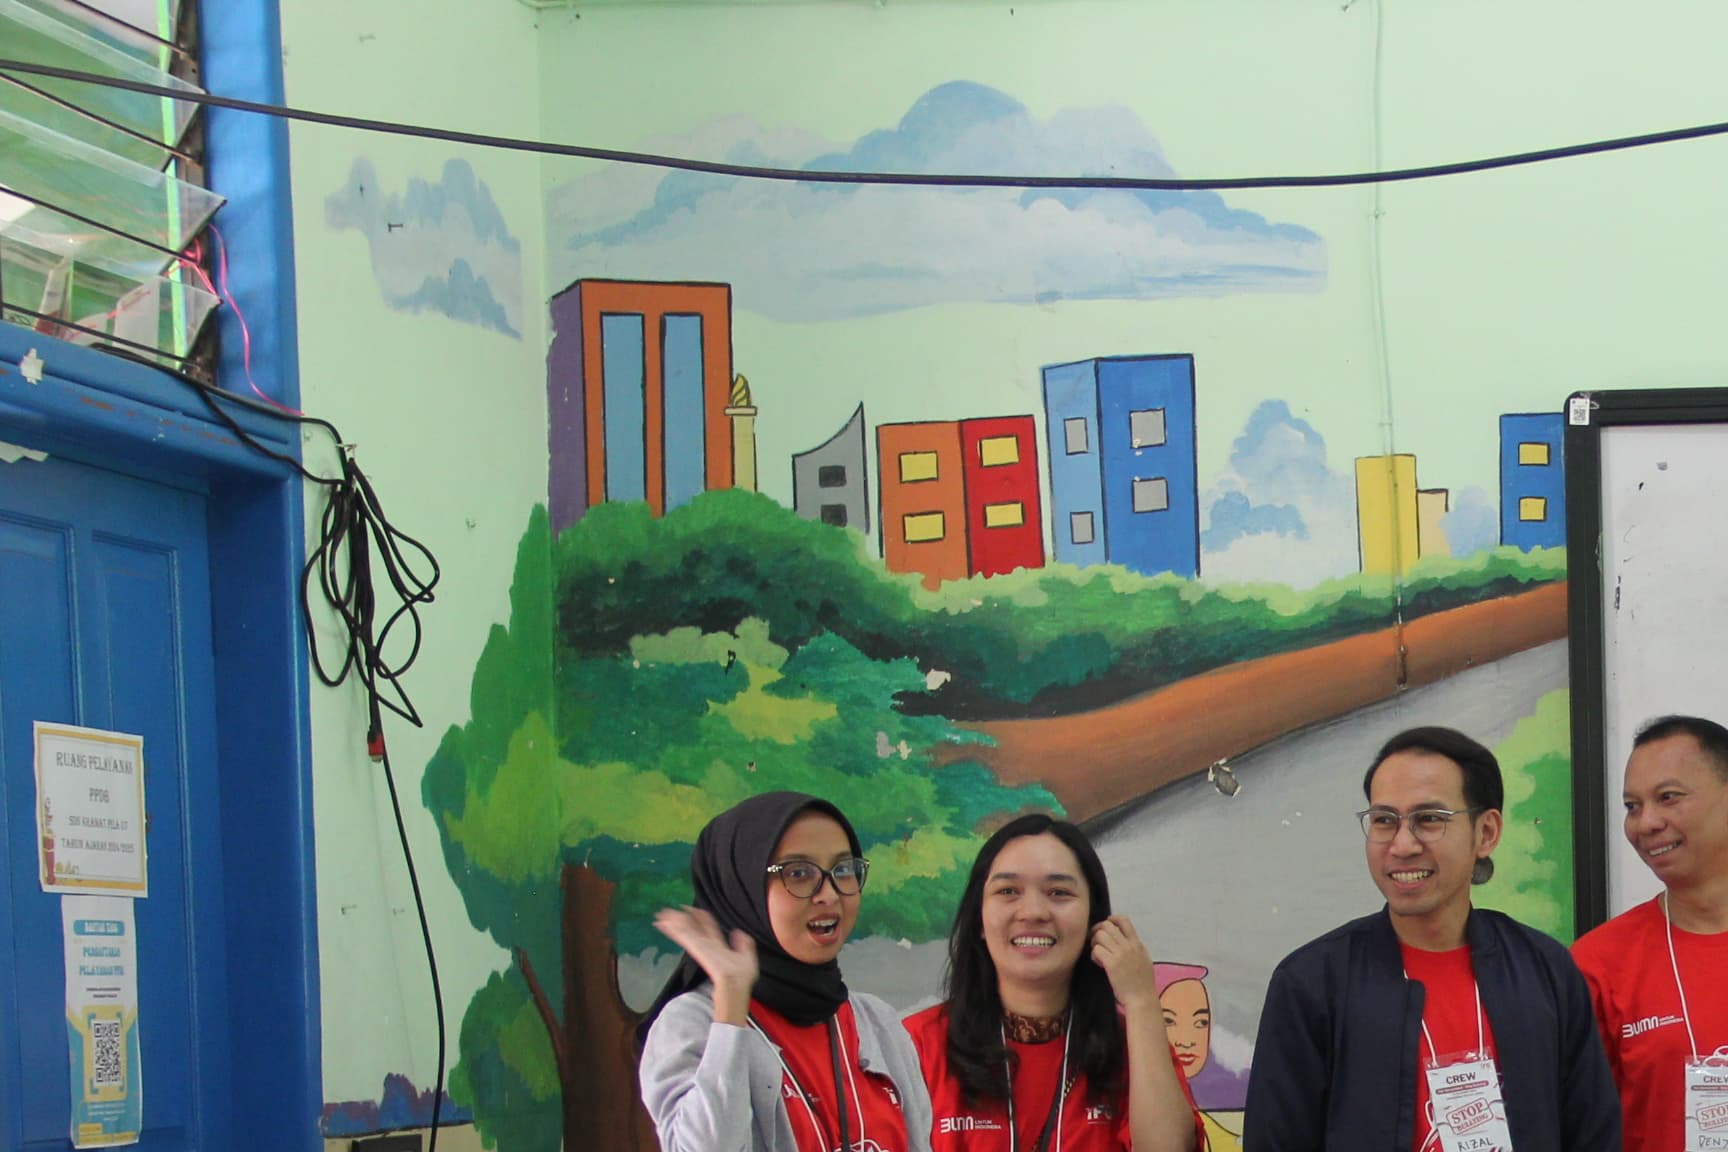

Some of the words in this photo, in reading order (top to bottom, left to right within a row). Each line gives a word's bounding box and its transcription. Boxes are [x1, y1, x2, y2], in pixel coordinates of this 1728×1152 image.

[1446, 1072, 1476, 1085] CREW
[1451, 1102, 1483, 1124] STOP
[1457, 1137, 1494, 1152] RIZAL
